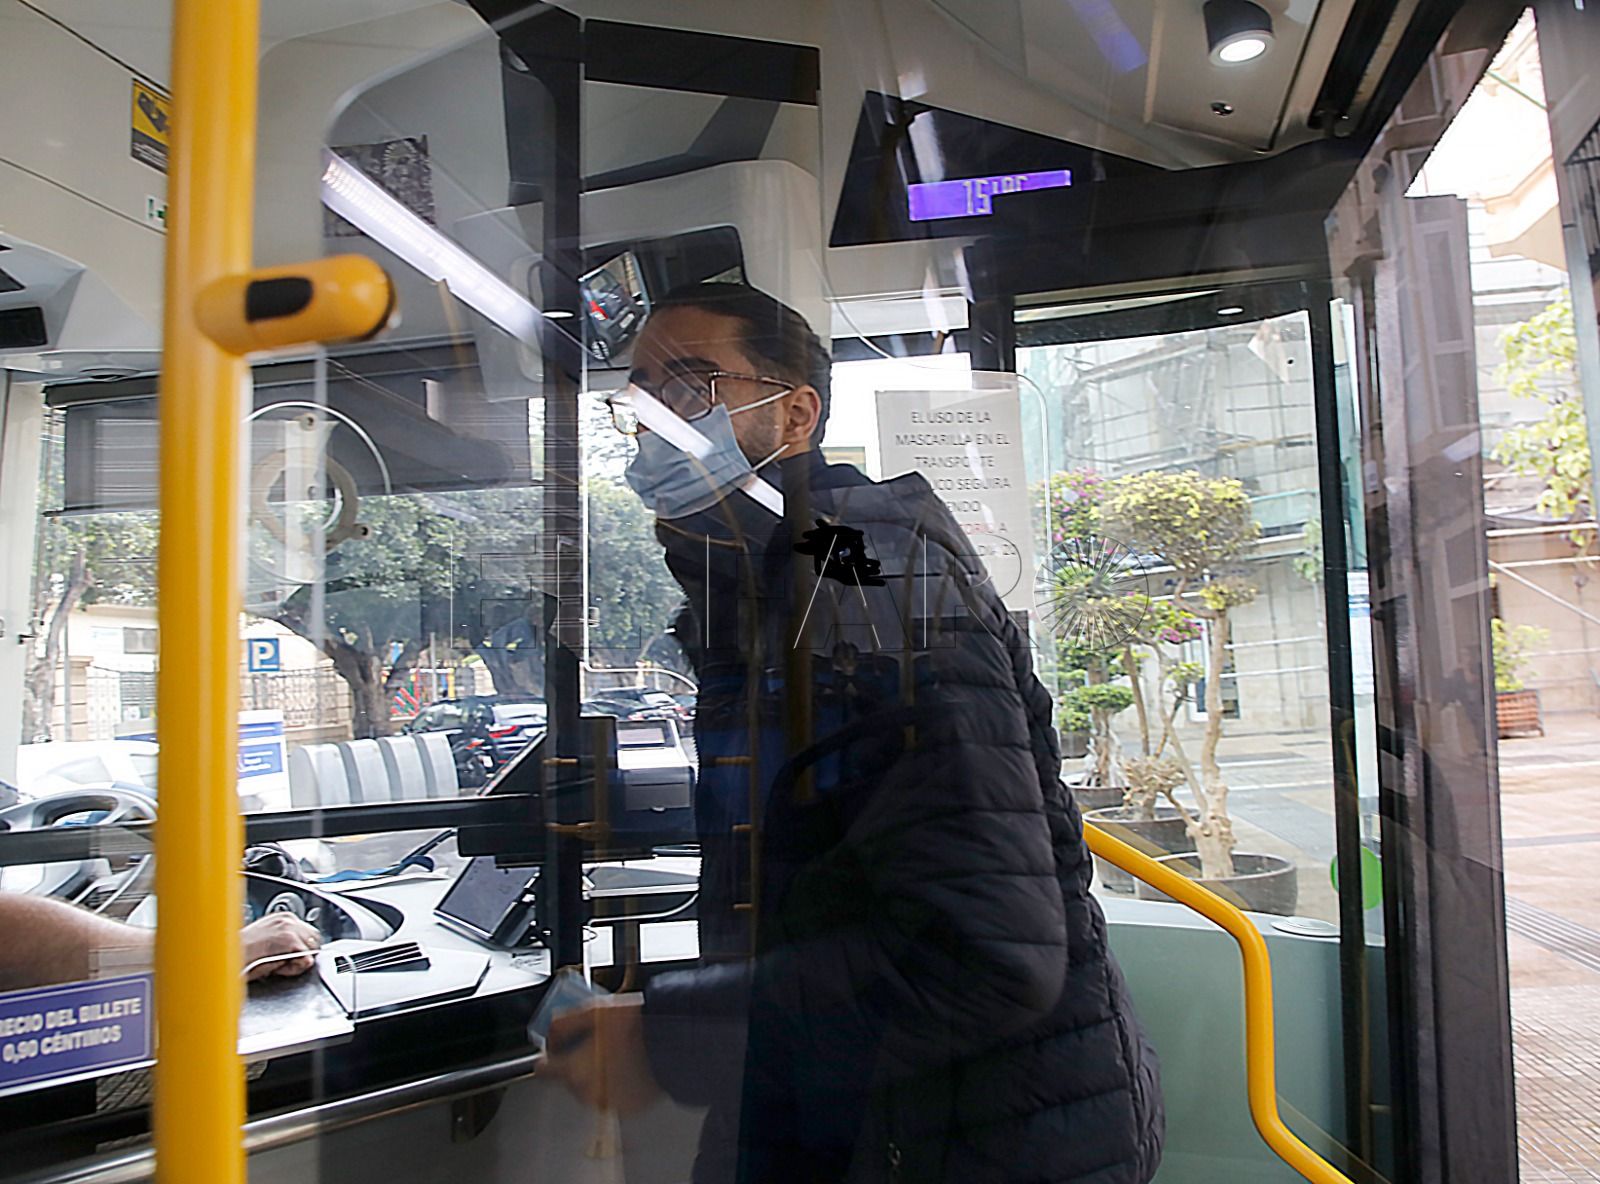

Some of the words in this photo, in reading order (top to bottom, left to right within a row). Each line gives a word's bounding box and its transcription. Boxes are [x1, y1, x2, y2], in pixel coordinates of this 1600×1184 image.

[911, 411, 925, 424] EL
[927, 411, 954, 424] USO
[957, 411, 974, 424] DE
[976, 411, 992, 424] LA
[895, 433, 973, 446] MASCARILLA
[976, 433, 993, 446] EN
[996, 433, 1011, 445] EL
[914, 455, 996, 469] TRANSPOTE
[252, 641, 275, 669] P
[45, 1008, 77, 1029] DEL
[79, 997, 142, 1023] BILLETE
[3, 1039, 39, 1064] 0,90
[40, 1025, 122, 1055] CÉNTIMOS
